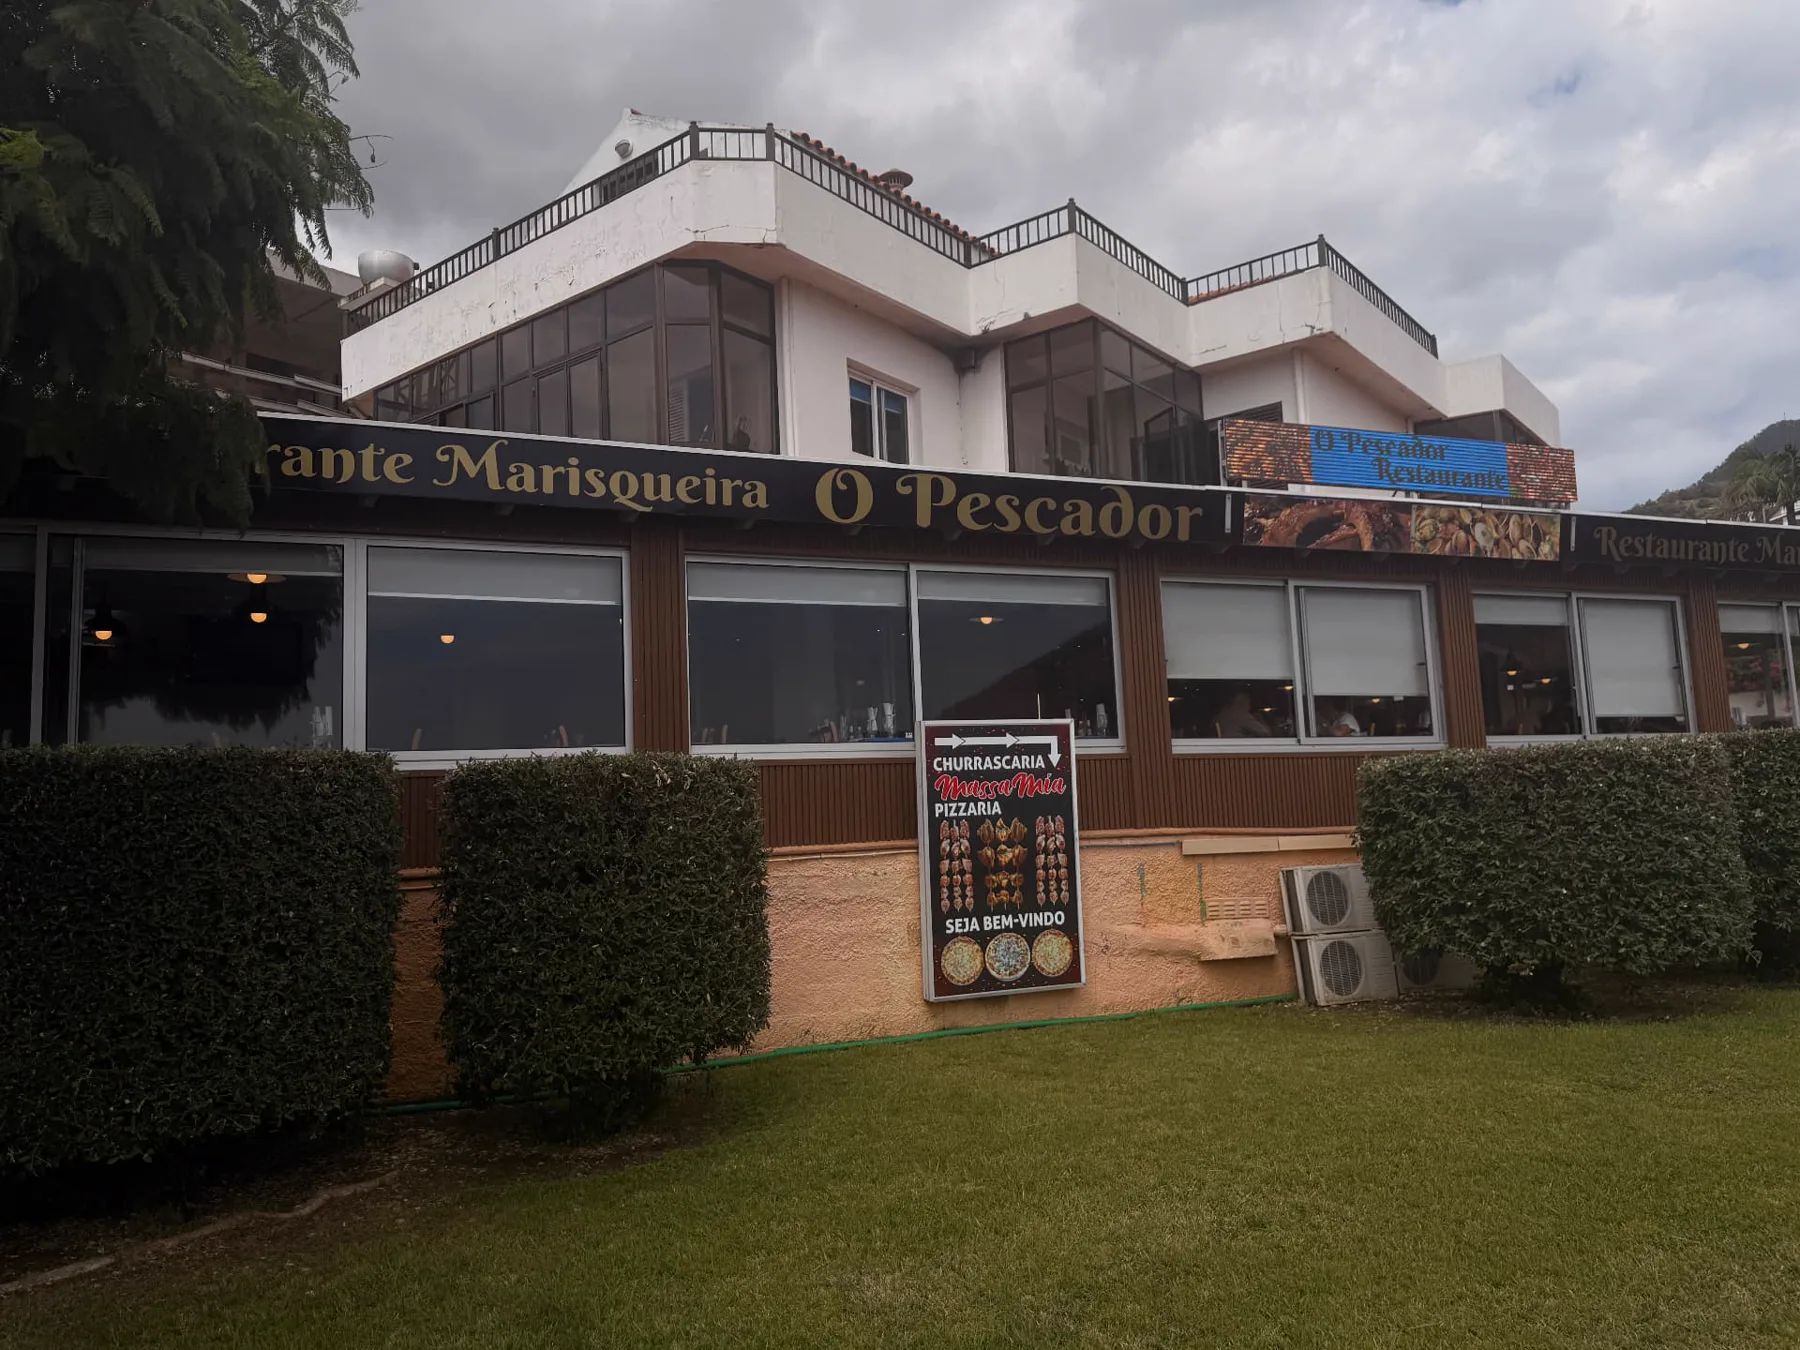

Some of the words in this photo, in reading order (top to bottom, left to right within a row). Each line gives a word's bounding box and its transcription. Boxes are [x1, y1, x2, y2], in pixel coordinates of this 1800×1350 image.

[1315, 430, 1334, 451] O
[1342, 431, 1448, 461] Pescador
[1371, 457, 1506, 491] Restaurante
[433, 439, 770, 512] Marisqueira
[815, 467, 874, 524] O
[895, 473, 1204, 542] Pescador
[1593, 526, 1750, 564] Restaurante
[933, 755, 1046, 771] CHURRASCARIA
[935, 800, 1002, 818] PIZZARIA
[945, 917, 980, 934] SEJA
[983, 910, 1066, 931] BEM-VINDO
